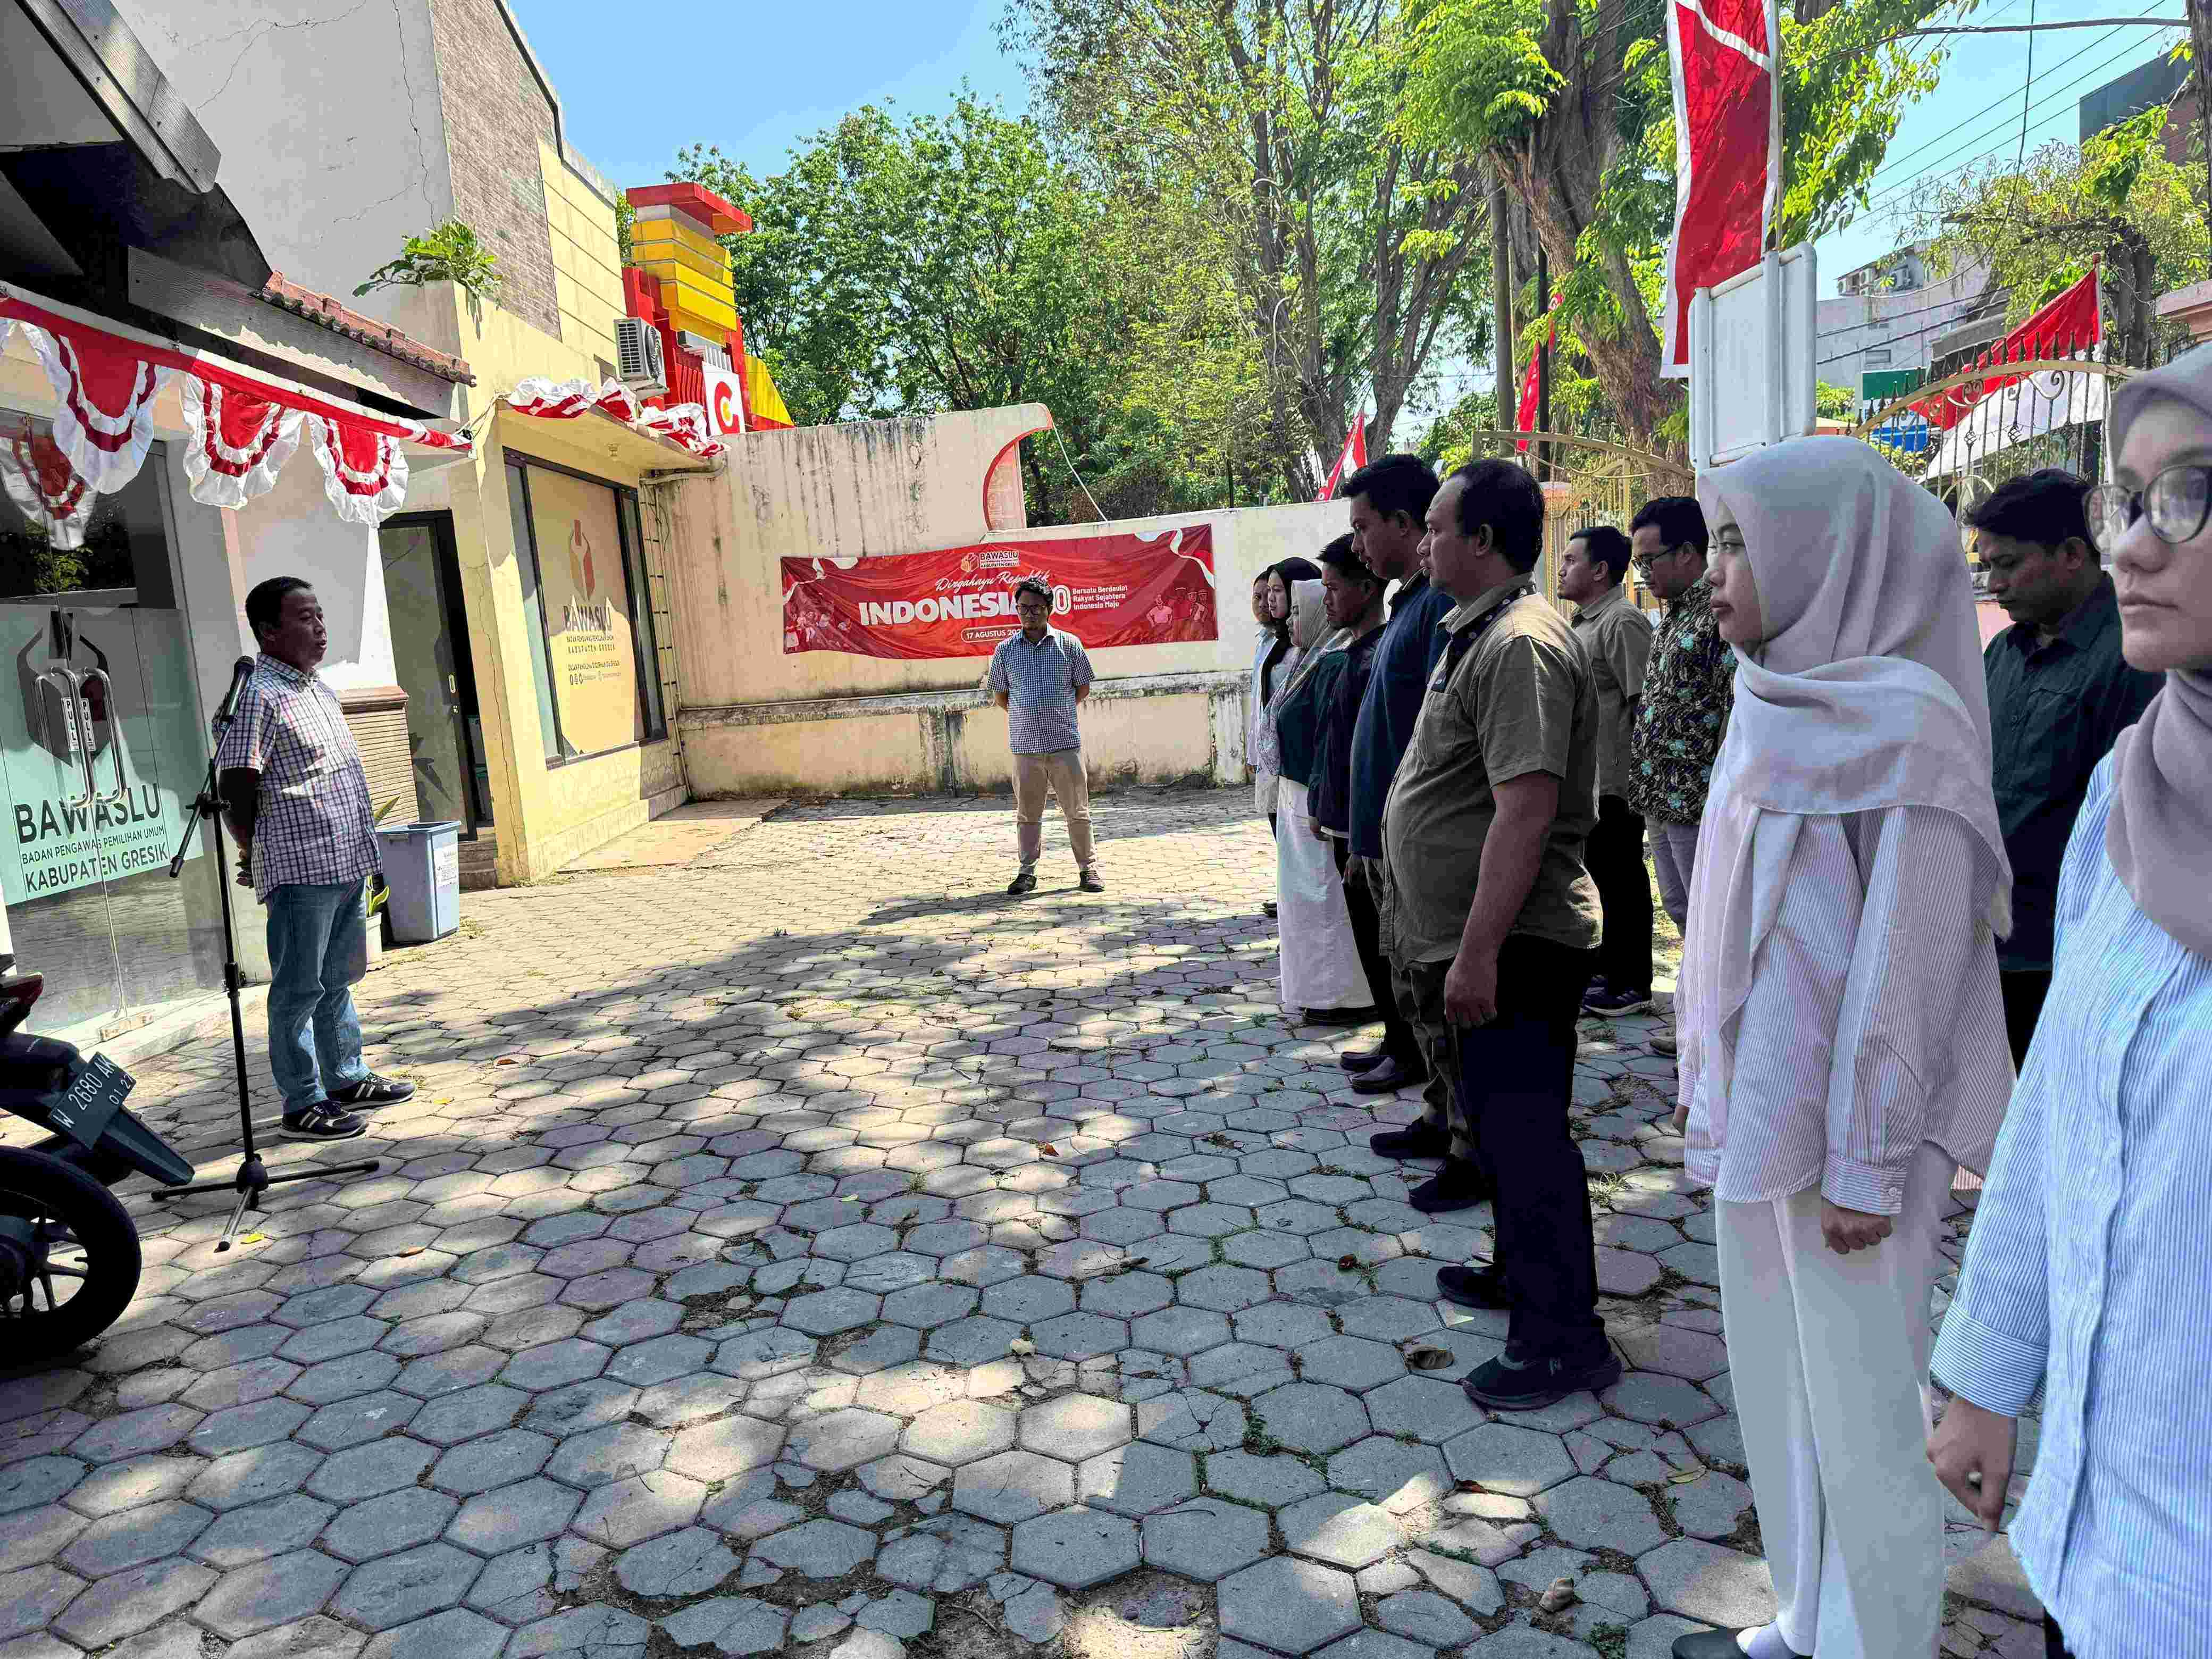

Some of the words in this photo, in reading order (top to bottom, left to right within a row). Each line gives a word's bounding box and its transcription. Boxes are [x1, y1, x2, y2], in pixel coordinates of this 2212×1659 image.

[936, 574, 996, 593] Dirgahayu
[1096, 592, 1126, 601] Sejahtera
[975, 630, 1007, 638] AGUSTUS
[66, 700, 77, 741] PULL
[82, 701, 92, 741] PULL
[14, 783, 161, 844] BAWASLU
[22, 850, 54, 865] BADAN
[55, 839, 102, 858] PENGAWAS
[104, 831, 143, 848] PEMILIHAN
[144, 825, 165, 839] UMUM
[25, 856, 118, 893] KABUPATEN
[121, 842, 169, 870] GRESIK
[53, 1109, 76, 1129] W
[68, 1072, 103, 1111] 2680
[93, 1054, 119, 1079] AK
[109, 1088, 124, 1105] 01
[120, 1073, 133, 1090] 27
